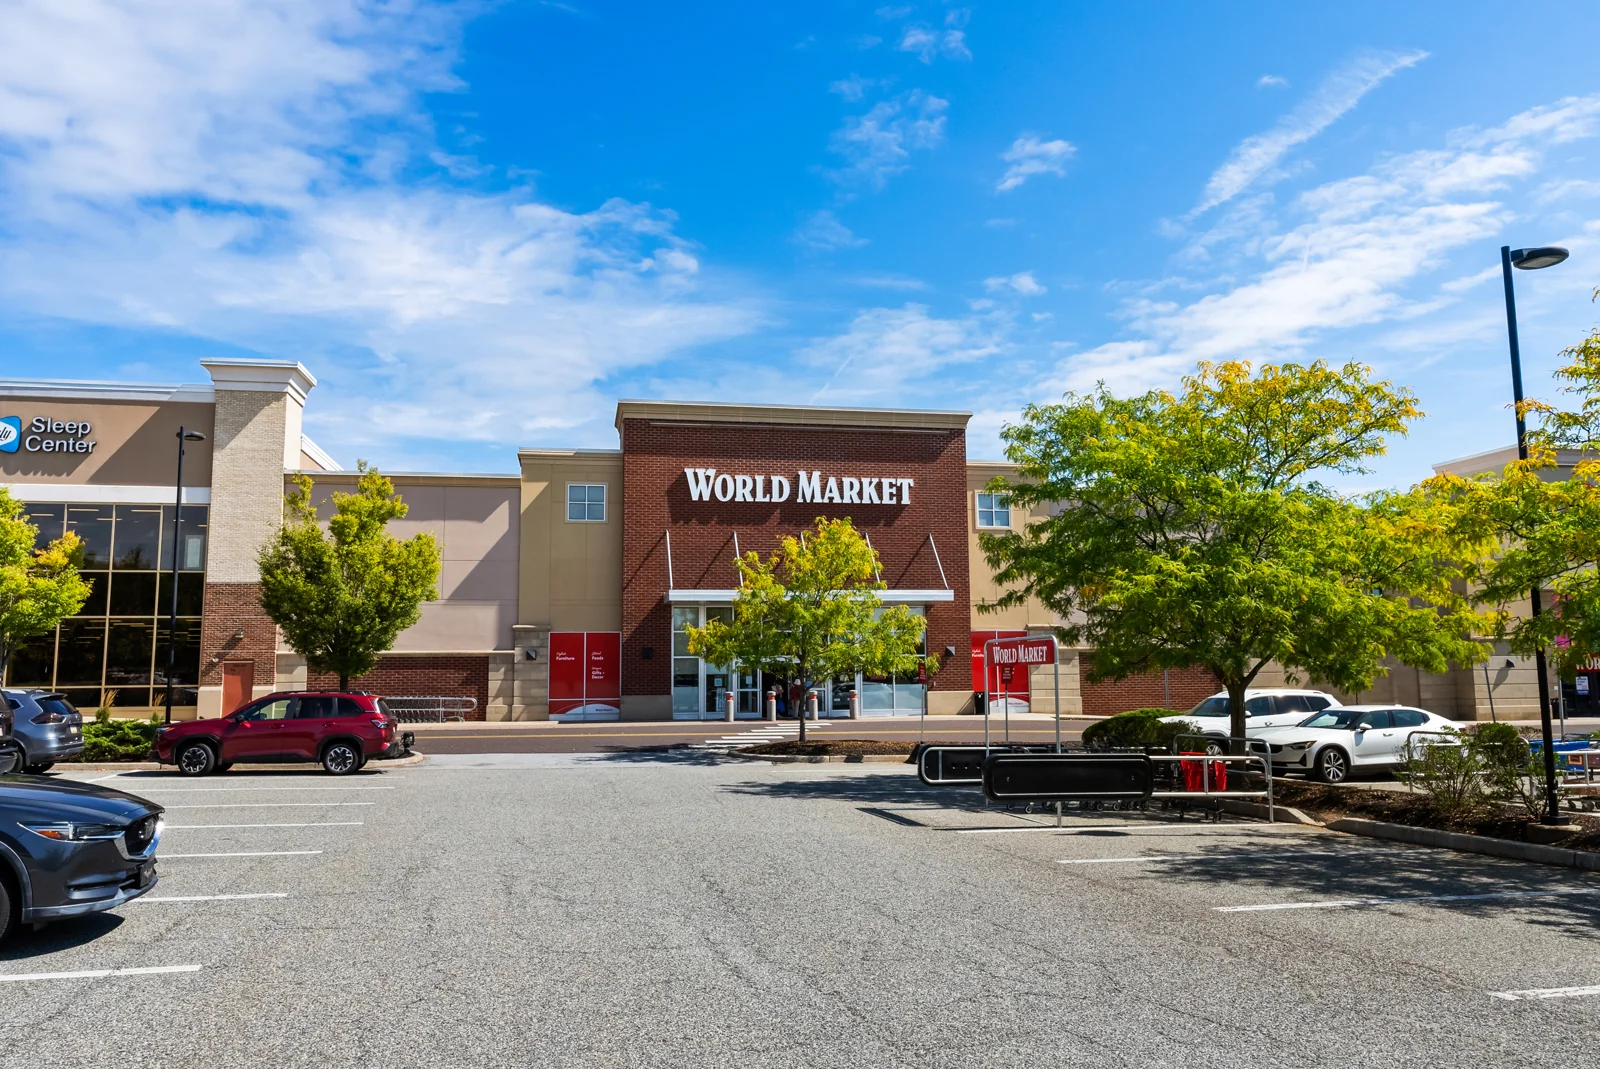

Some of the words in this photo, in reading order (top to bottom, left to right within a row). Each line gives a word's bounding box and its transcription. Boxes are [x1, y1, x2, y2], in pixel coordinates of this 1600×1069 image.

[31, 416, 91, 438] Sleep
[25, 435, 96, 453] Center
[684, 467, 791, 503] WORLD
[796, 470, 914, 505] MARKET
[993, 646, 1017, 664] WORLD
[1018, 644, 1047, 663] MARKET
